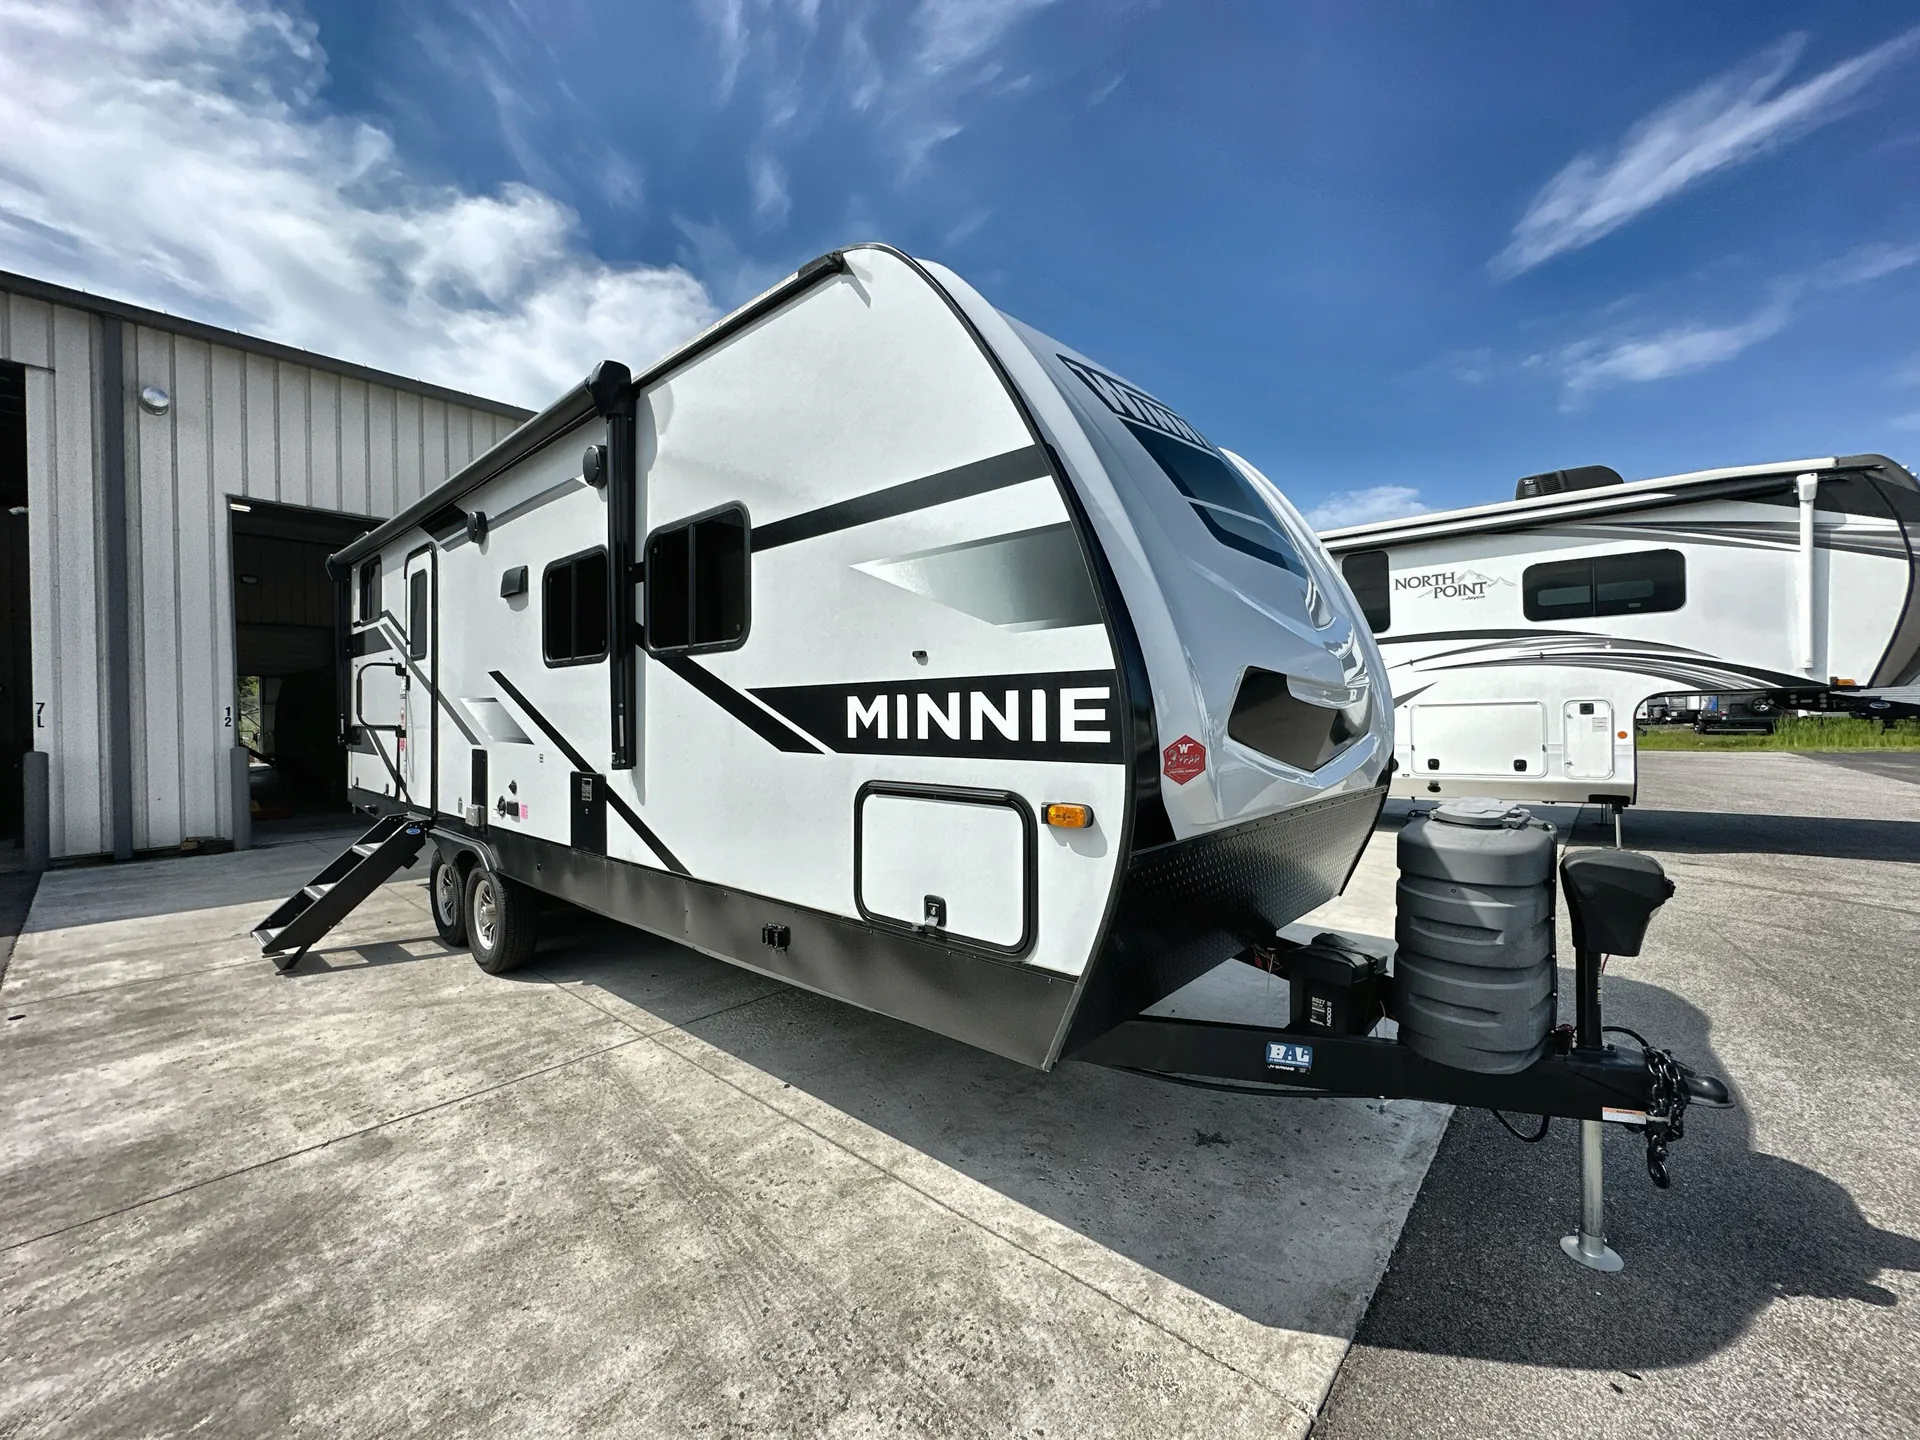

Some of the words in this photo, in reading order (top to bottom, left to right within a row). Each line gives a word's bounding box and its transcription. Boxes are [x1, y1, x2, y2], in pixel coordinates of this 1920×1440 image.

[1394, 572, 1455, 591] NORTH
[1433, 581, 1487, 599] POINT
[847, 687, 1111, 743] MINNIE
[1168, 750, 1177, 768] 3
